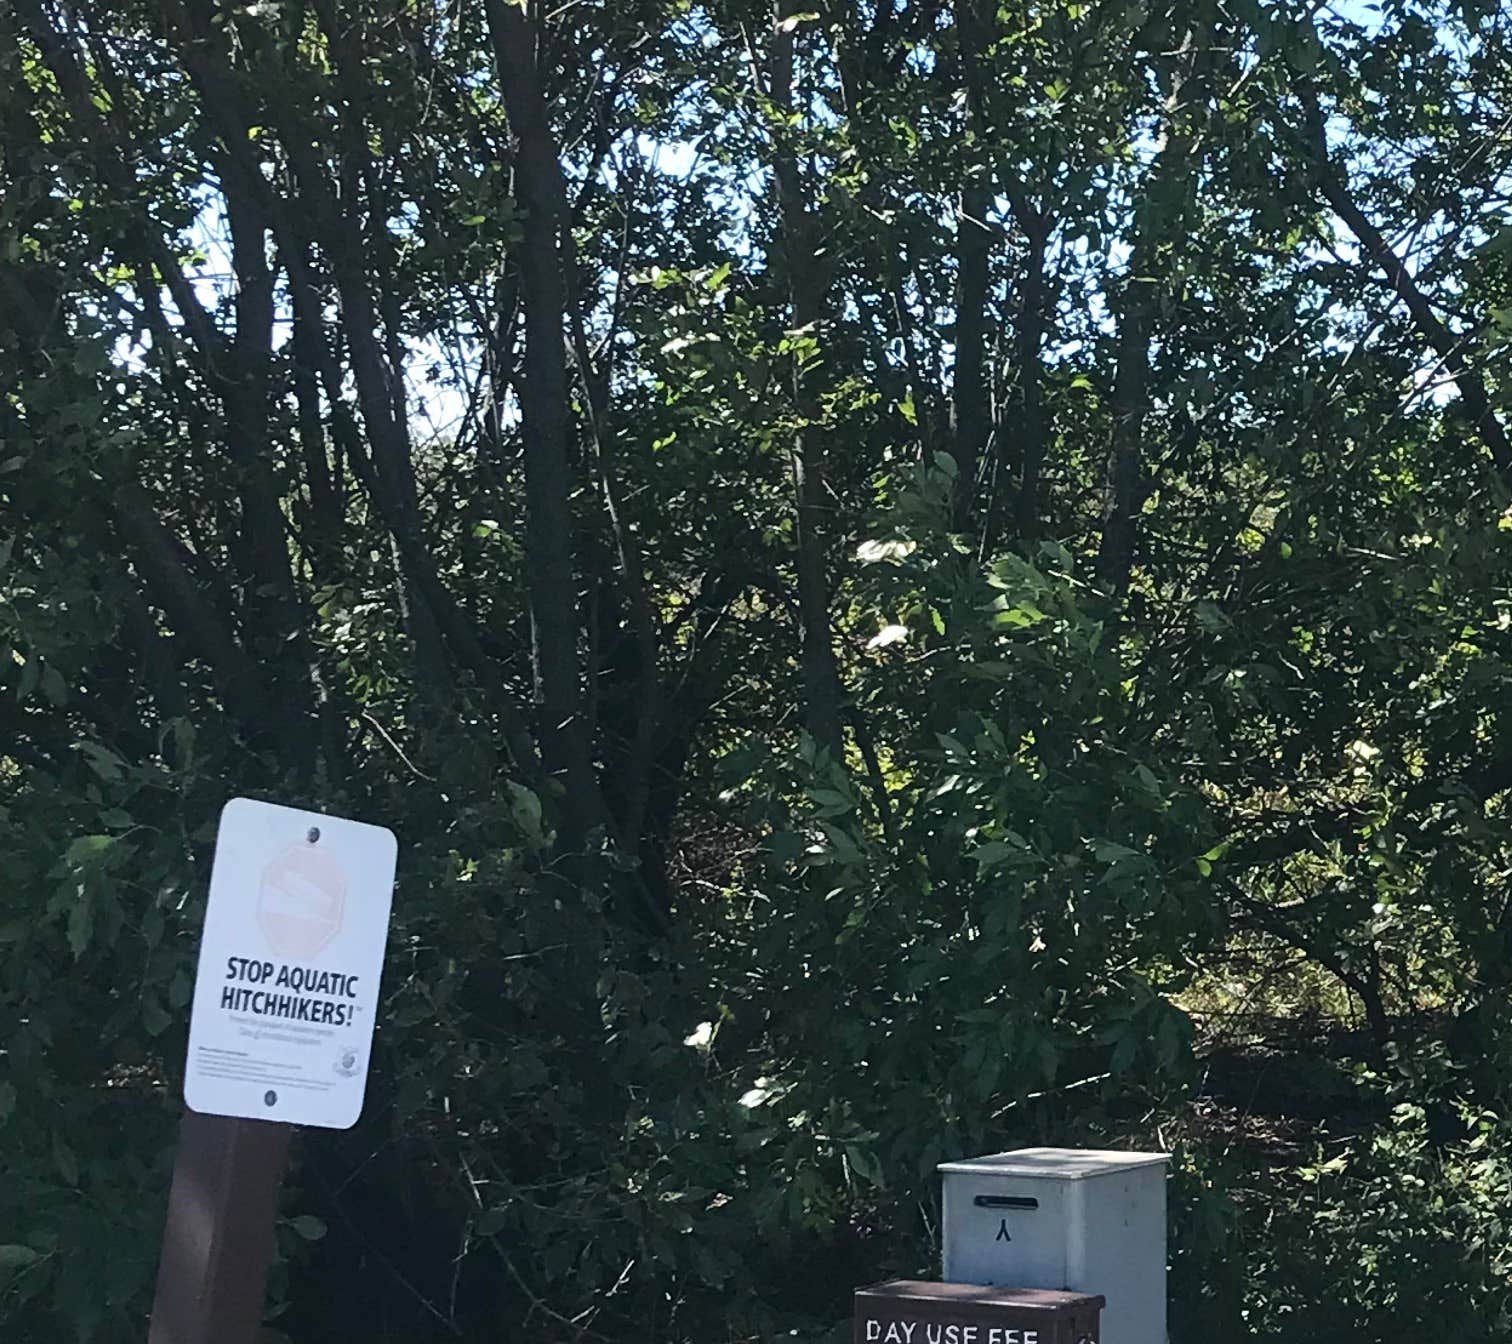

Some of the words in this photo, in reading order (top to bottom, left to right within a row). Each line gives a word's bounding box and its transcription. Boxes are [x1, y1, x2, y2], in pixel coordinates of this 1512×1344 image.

[226, 956, 274, 984] STOP
[275, 965, 359, 998] AQUATIC
[220, 986, 353, 1026] HITCHHIKERS!
[866, 1319, 917, 1344] DAY
